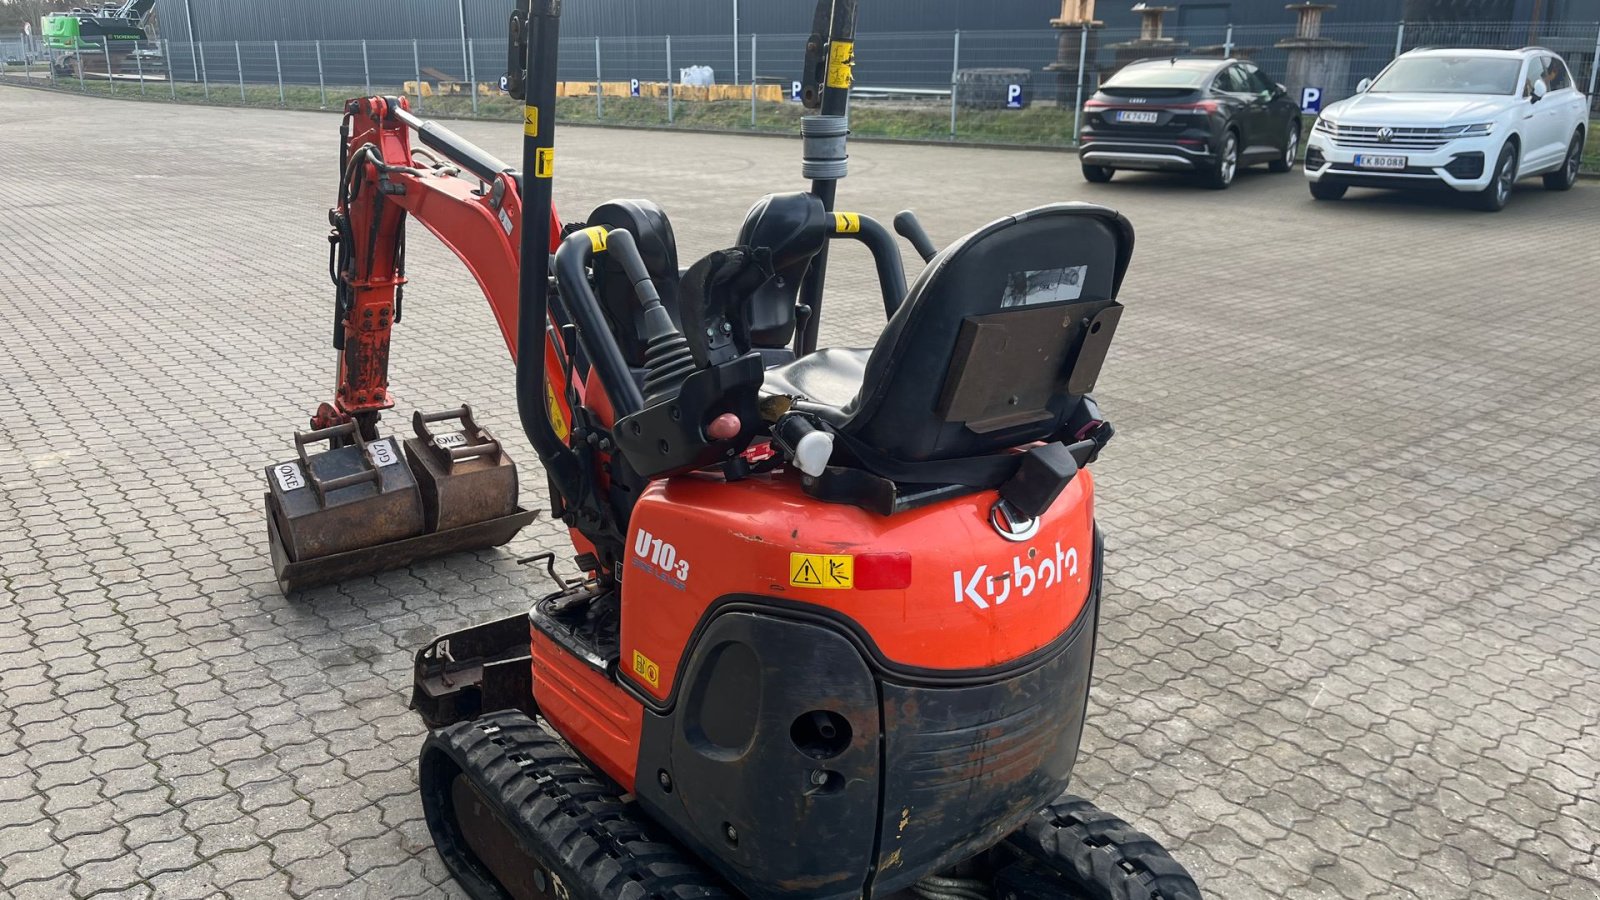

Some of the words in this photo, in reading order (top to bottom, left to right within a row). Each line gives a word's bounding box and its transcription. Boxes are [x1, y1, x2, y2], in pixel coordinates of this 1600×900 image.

[631, 79, 639, 93] P
[792, 81, 801, 97] P
[1008, 84, 1020, 102] P
[1302, 88, 1320, 108] P
[280, 465, 299, 489] ØKE
[635, 528, 689, 581] U10-3
[953, 541, 1078, 609] Kubota
